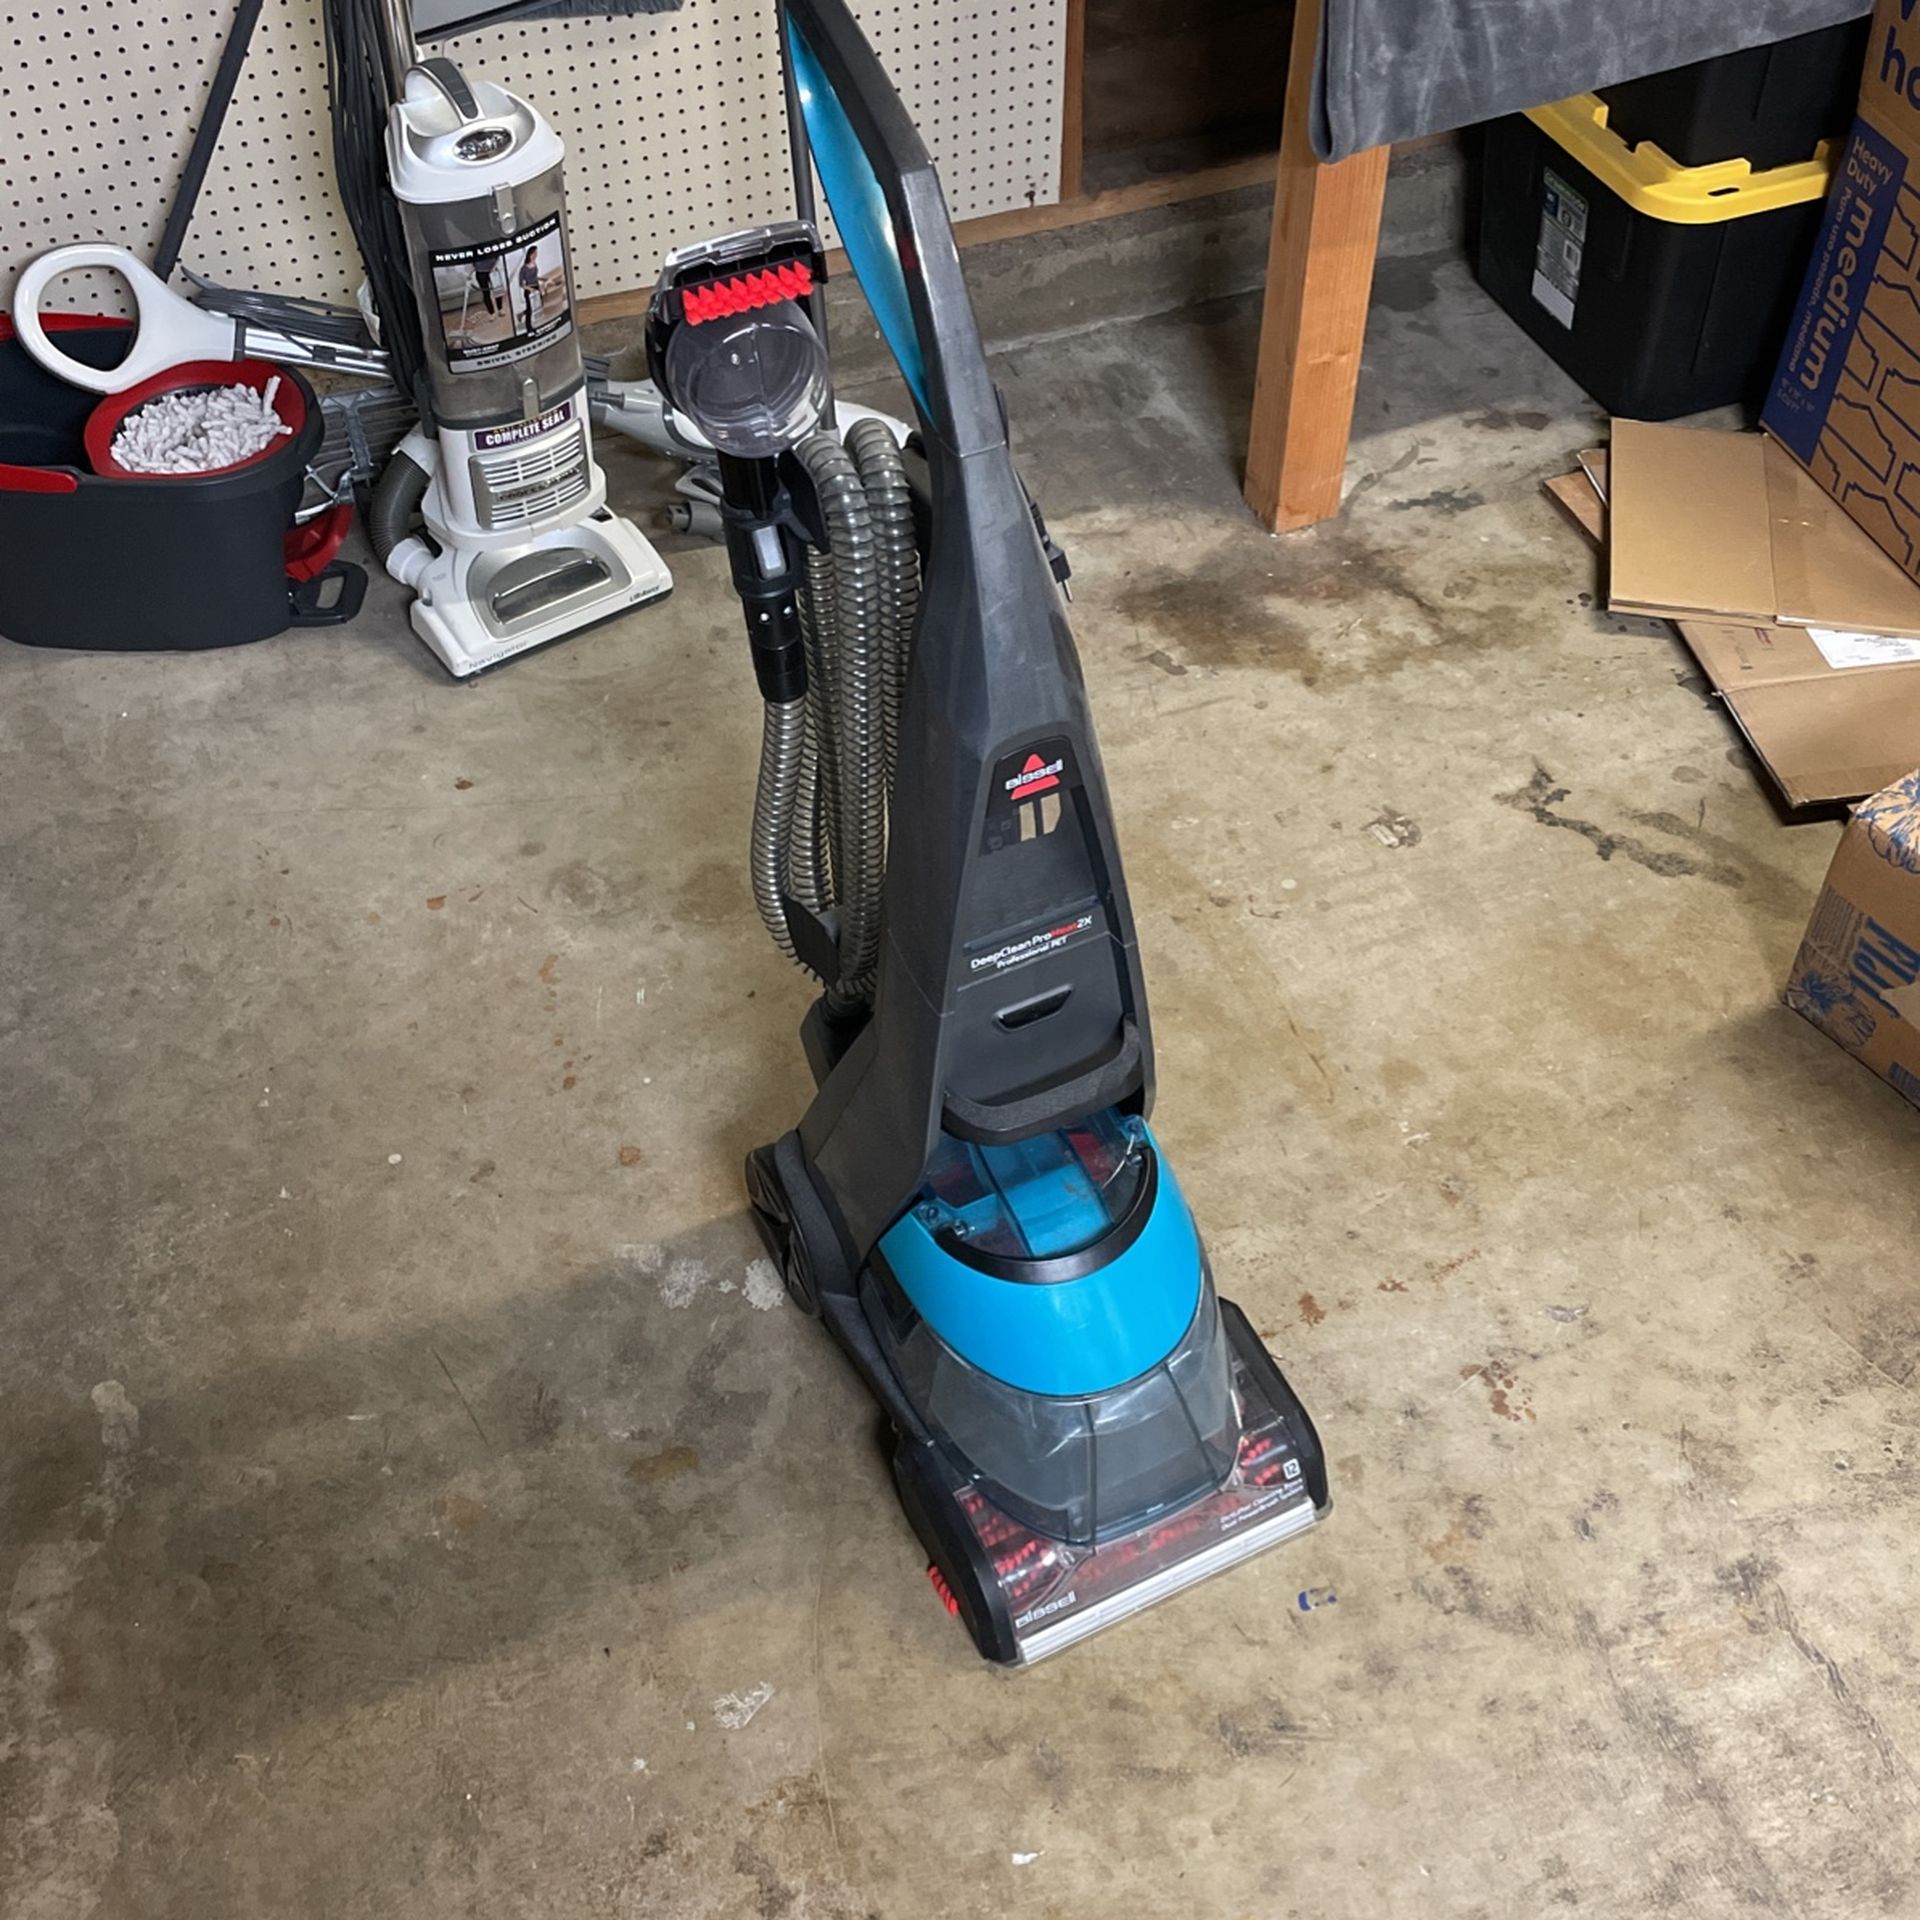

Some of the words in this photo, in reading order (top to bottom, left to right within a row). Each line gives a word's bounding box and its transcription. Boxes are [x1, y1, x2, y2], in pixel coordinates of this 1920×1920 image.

[1847, 158, 1878, 196] Duty
[1853, 136, 1893, 185] Heavy
[435, 250, 474, 262] NEVER
[477, 240, 513, 256] LOSES
[515, 218, 556, 244] SUCTION
[1800, 196, 1873, 391] medium
[477, 354, 512, 367] SWIVEL
[515, 334, 557, 357] STEERING
[485, 422, 540, 446] COMPLETE
[541, 410, 565, 431] SEAL
[970, 939, 1032, 969] DeepClean
[996, 942, 1051, 969] Professional
[1050, 934, 1069, 949] PET
[1284, 1461, 1299, 1477] 12
